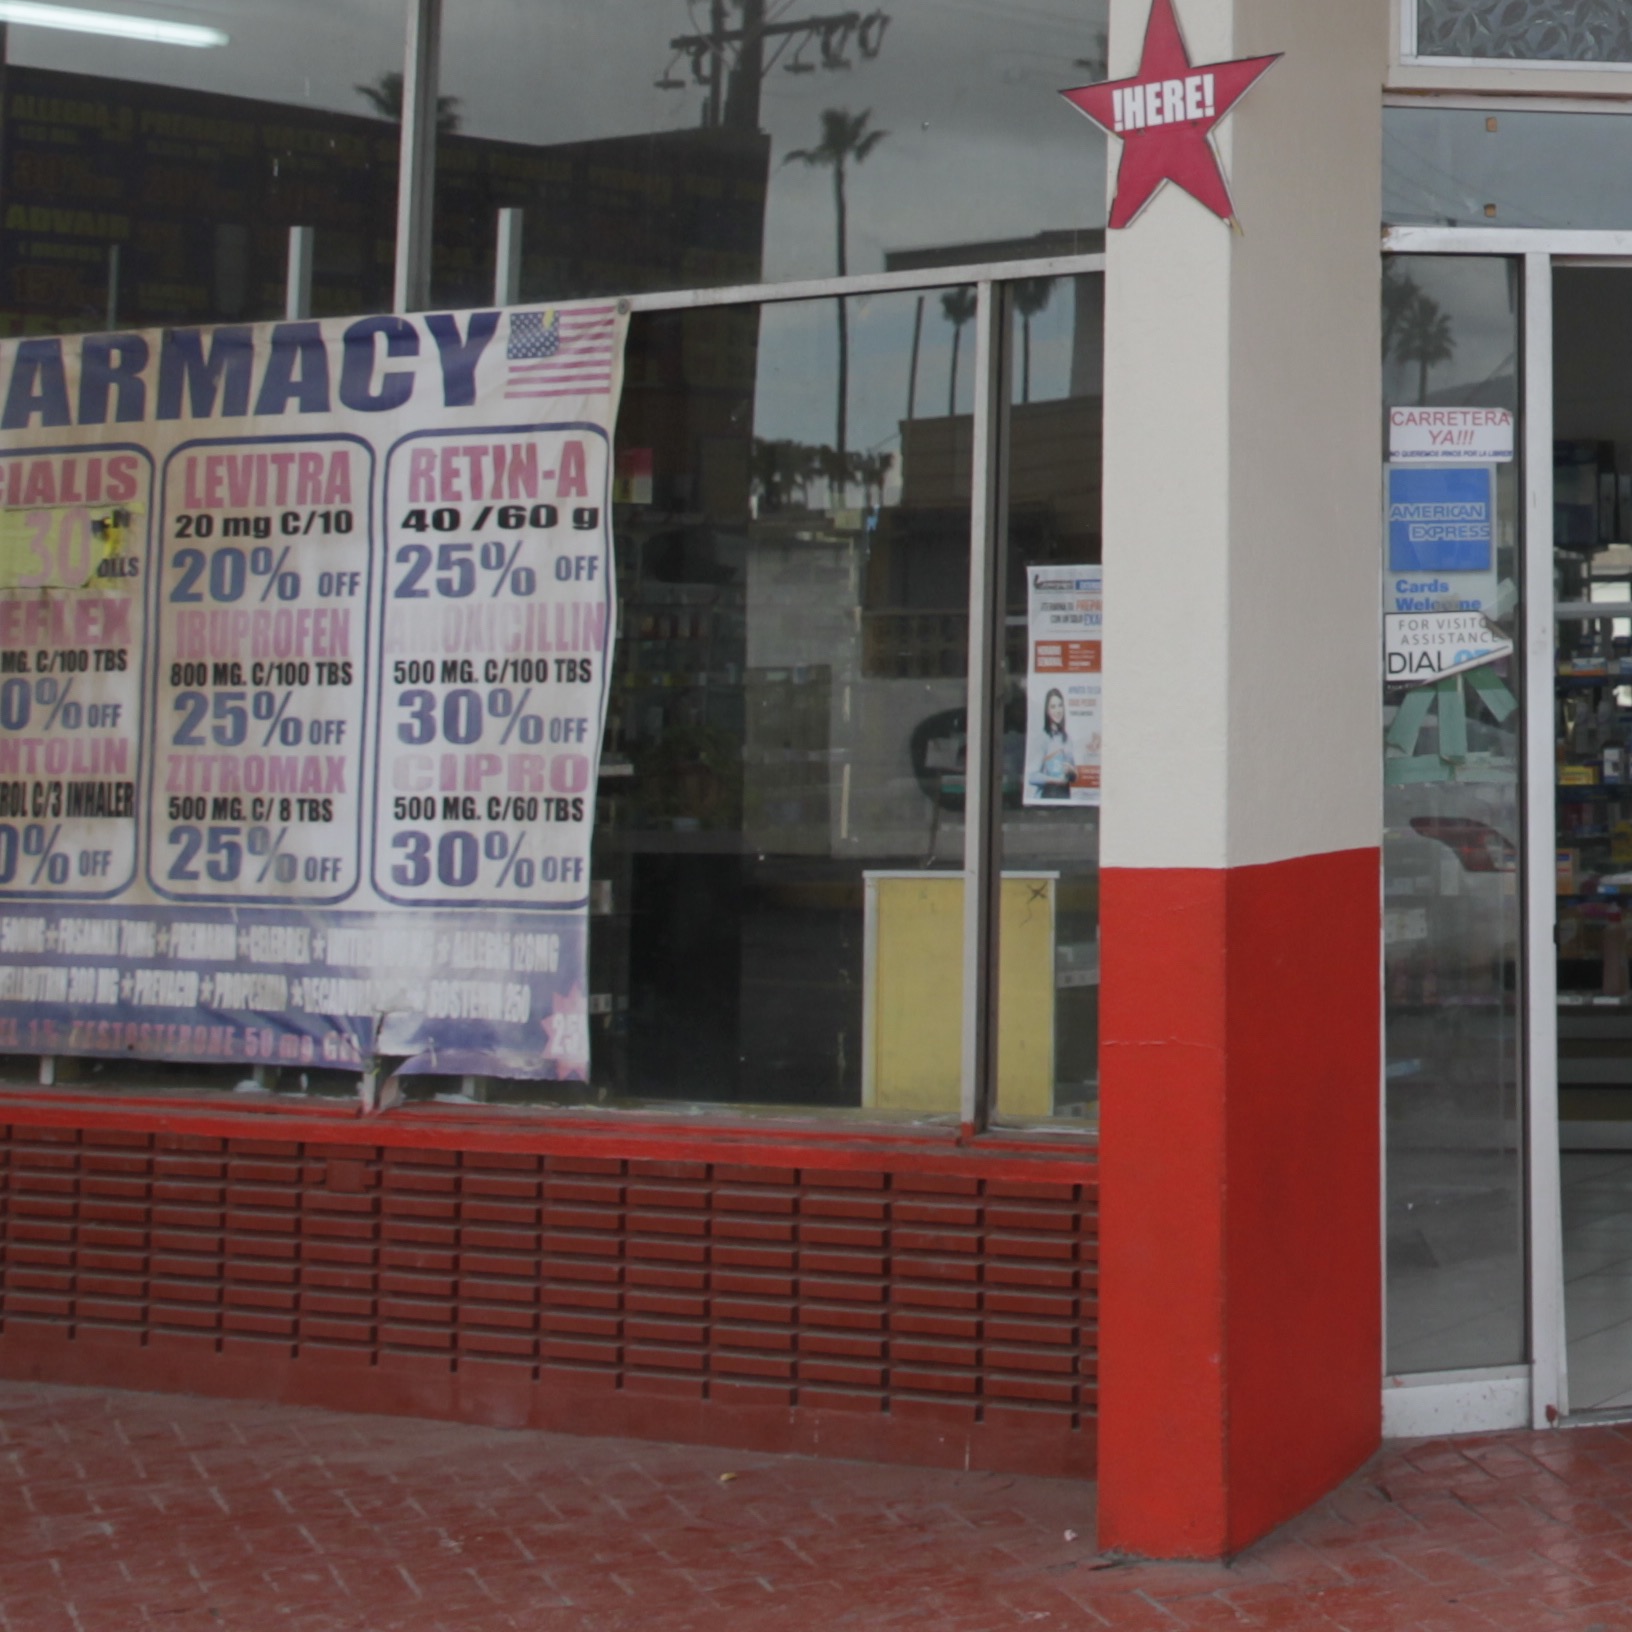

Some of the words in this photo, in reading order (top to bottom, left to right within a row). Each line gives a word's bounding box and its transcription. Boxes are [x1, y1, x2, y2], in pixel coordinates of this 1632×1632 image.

[1112, 73, 1215, 132] !HERE!
[0, 311, 502, 431] ARMACY
[1391, 411, 1511, 427] CARRETERA
[1429, 429, 1475, 446] YA!!!
[0, 454, 139, 506] IALIS
[184, 450, 351, 510] LEVITRA
[408, 440, 588, 503] RETIN-A
[174, 514, 214, 539] 20
[222, 518, 272, 542] mg
[280, 509, 354, 536] C/10
[400, 508, 462, 533] 40
[572, 507, 600, 531] g
[1390, 504, 1484, 520] AMERICAN
[1410, 524, 1490, 540] EXPRESS
[168, 545, 301, 604] 20%
[317, 571, 361, 598] OFF
[393, 539, 537, 599] 25%
[554, 555, 600, 581] OFF
[1395, 579, 1450, 593] Cards
[176, 607, 351, 660] IBUPROFEN
[1398, 619, 1430, 631] FOR
[35, 649, 88, 672] C/100
[93, 648, 128, 671] TBS
[170, 662, 208, 687] 800
[212, 662, 248, 687] MG.
[251, 661, 310, 686] C/100
[315, 660, 353, 686] TBS
[393, 659, 436, 684] 500
[441, 660, 479, 685] MG.
[484, 658, 549, 684] C/100
[554, 658, 593, 683] TBS
[1387, 650, 1445, 674] DIAL
[87, 703, 122, 728] OFF
[172, 690, 303, 748] 25%
[309, 718, 348, 746] OFF
[397, 687, 545, 746] 30%
[549, 716, 589, 744] OFF
[164, 753, 347, 795] ZITROMAX
[392, 752, 590, 793] CIPRO
[66, 780, 135, 819] INHALER
[168, 796, 207, 821] 500
[211, 796, 247, 821] MG.
[296, 798, 334, 823] TBS
[393, 796, 437, 821] 500
[442, 796, 481, 821] MG.
[487, 796, 539, 821] C/60
[543, 797, 585, 822] TBS
[78, 849, 112, 877] OFF
[167, 824, 299, 884] 25%
[303, 856, 343, 883] OFF
[391, 829, 535, 889] 30%
[541, 855, 584, 883] OFF
[71, 1020, 236, 1057] TESTOSTERONE
[244, 1026, 275, 1058] 50
